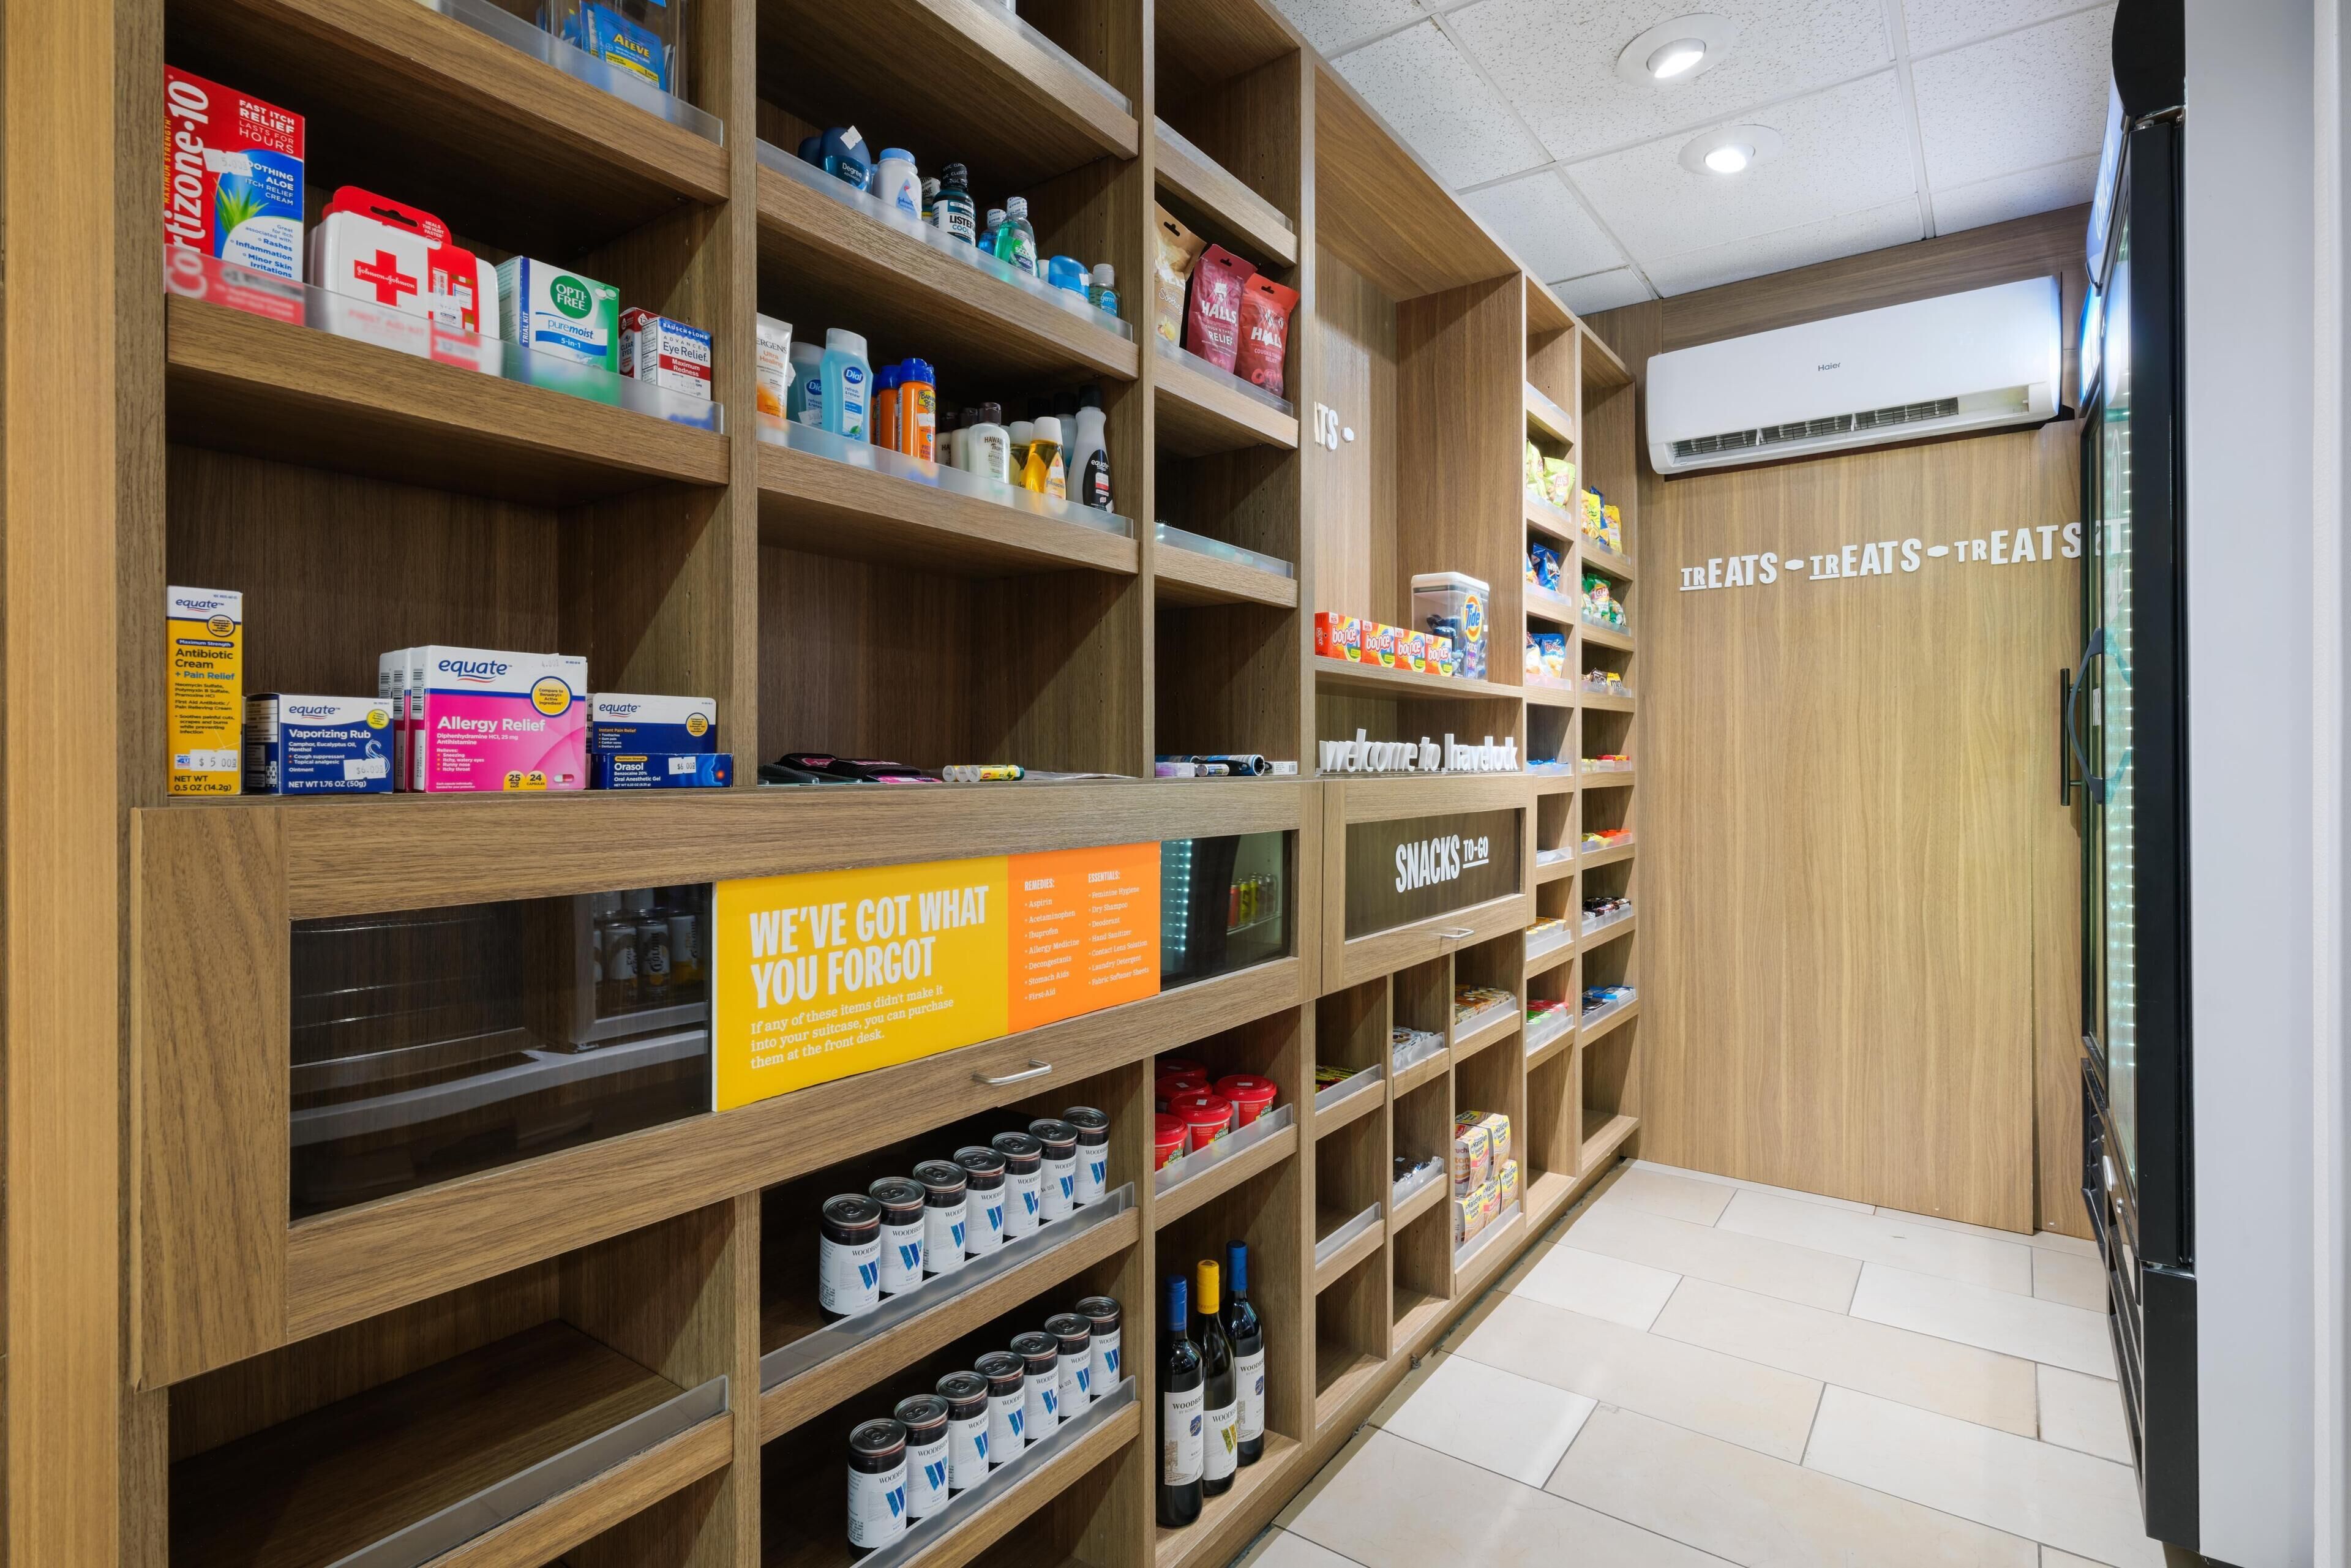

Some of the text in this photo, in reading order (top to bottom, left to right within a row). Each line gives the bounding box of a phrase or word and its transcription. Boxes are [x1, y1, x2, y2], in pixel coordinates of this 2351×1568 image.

[239, 99, 294, 125] FAST ITCH
[239, 108, 294, 134] RELIEF
[239, 120, 294, 144] LASTS FOR
[239, 127, 294, 154] HOURS
[247, 159, 294, 182] OOTHING
[841, 162, 863, 178] Degree
[245, 179, 293, 197] ITCH RELIEF
[266, 177, 294, 190] ALOE
[266, 193, 293, 206] CREAM
[236, 240, 292, 261] Inflammation
[263, 238, 293, 252] Rashes
[248, 253, 292, 271] Minor Skin
[250, 261, 292, 278] Irritations
[557, 296, 587, 311] FREE
[1202, 300, 1237, 323] HALLS
[548, 318, 594, 339] puremoist
[561, 337, 581, 348] 5-in-1
[664, 336, 707, 351] ADVANCED
[757, 339, 787, 354] ERGENS
[1208, 331, 1233, 347] RELIEF
[663, 342, 707, 362] Eye Relief
[763, 351, 779, 360] Ultra
[672, 358, 700, 371] Maximum
[760, 356, 784, 368] Healing
[1817, 362, 1841, 372] Haier
[673, 365, 699, 377] Redness
[846, 369, 863, 381] Dial
[1680, 522, 2081, 590] TREATS TREATS TREATS
[176, 599, 217, 610] equate
[1464, 602, 1481, 631] Tide
[1332, 627, 1357, 646] bounce
[1366, 634, 1390, 651] bounce
[176, 648, 233, 659] Antibiotic
[1398, 640, 1421, 657] bounce
[1428, 647, 1449, 662] bounce
[175, 659, 213, 669] Cream
[438, 659, 507, 677] equate
[289, 706, 335, 716] equate
[599, 703, 637, 715] equate
[438, 716, 546, 732] Allergy Relief
[289, 729, 371, 739] Vaporizing Rub
[1319, 729, 1518, 772] welcome to havelock
[614, 762, 643, 771] Orasol
[1396, 835, 1488, 893] SNACKS TO-GO
[1088, 870, 1120, 883] ESSENTIALS:
[1025, 878, 1055, 891] REMEDIES:
[1092, 887, 1139, 898] Feminine Hygiene
[1029, 898, 1052, 909] Aspirin
[1104, 901, 1128, 911] Shampoo
[749, 902, 847, 958] WE'VE
[856, 895, 910, 942] GOT
[919, 885, 989, 932] WHAT
[1029, 910, 1075, 923] Acetaminophen
[1092, 917, 1120, 928] Deodorant
[1029, 928, 1058, 939] Ibuprofen
[1108, 929, 1131, 939] Sanitizer
[1029, 939, 1079, 955] Allergy Medicine
[1092, 947, 1112, 956] Contact
[1127, 940, 1147, 949] Solution
[1029, 956, 1071, 970] Decongestants
[1092, 955, 1141, 971] Laundry Detergent
[750, 936, 936, 1008] YOU FORGOT
[1029, 970, 1069, 985] Stomach Aids
[1092, 967, 1149, 986] Fabric Softener Sheets
[1029, 988, 1056, 1000] First-Aid
[751, 985, 943, 1034] If any of these items didn't make it
[751, 999, 953, 1052] into your suitcase, you can purchase
[751, 1029, 885, 1070] them at the front desk.
